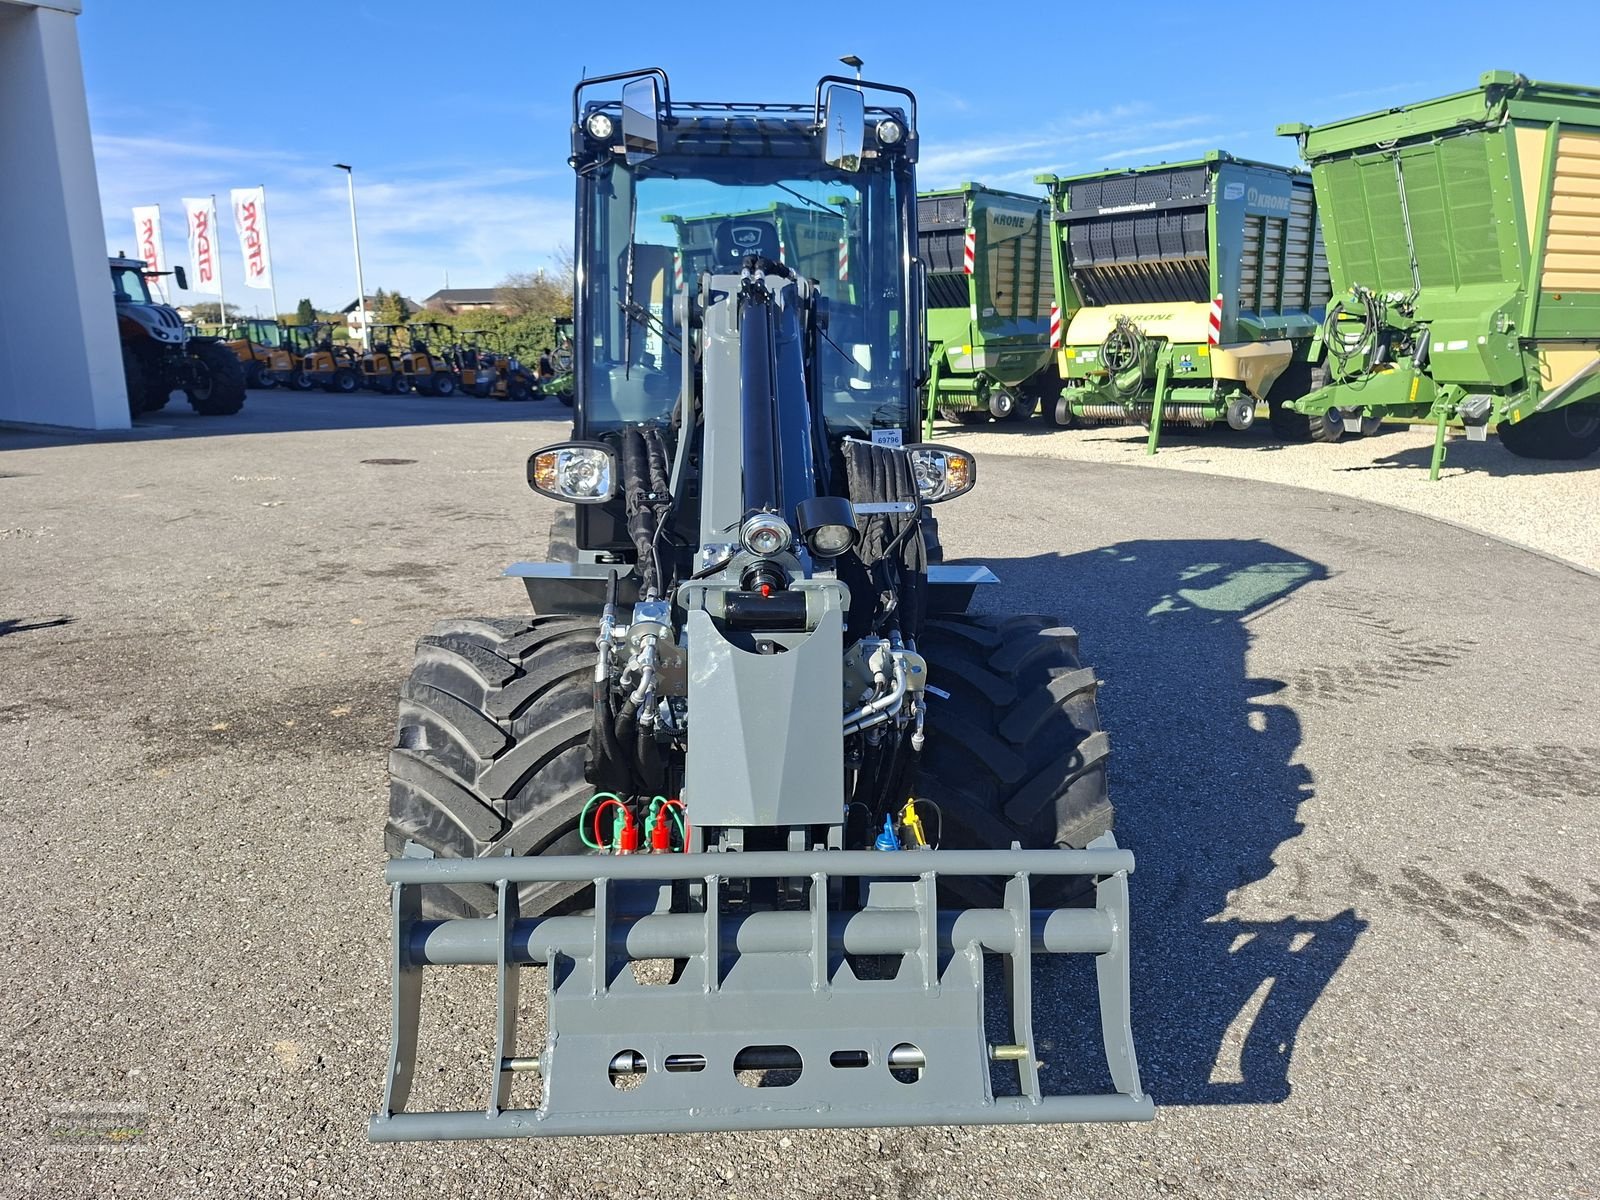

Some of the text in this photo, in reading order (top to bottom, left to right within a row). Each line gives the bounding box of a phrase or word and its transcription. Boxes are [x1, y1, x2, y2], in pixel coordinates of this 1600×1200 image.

[1257, 194, 1291, 210] KRONE
[993, 213, 1025, 228] KRONE
[877, 436, 899, 444] 69796
